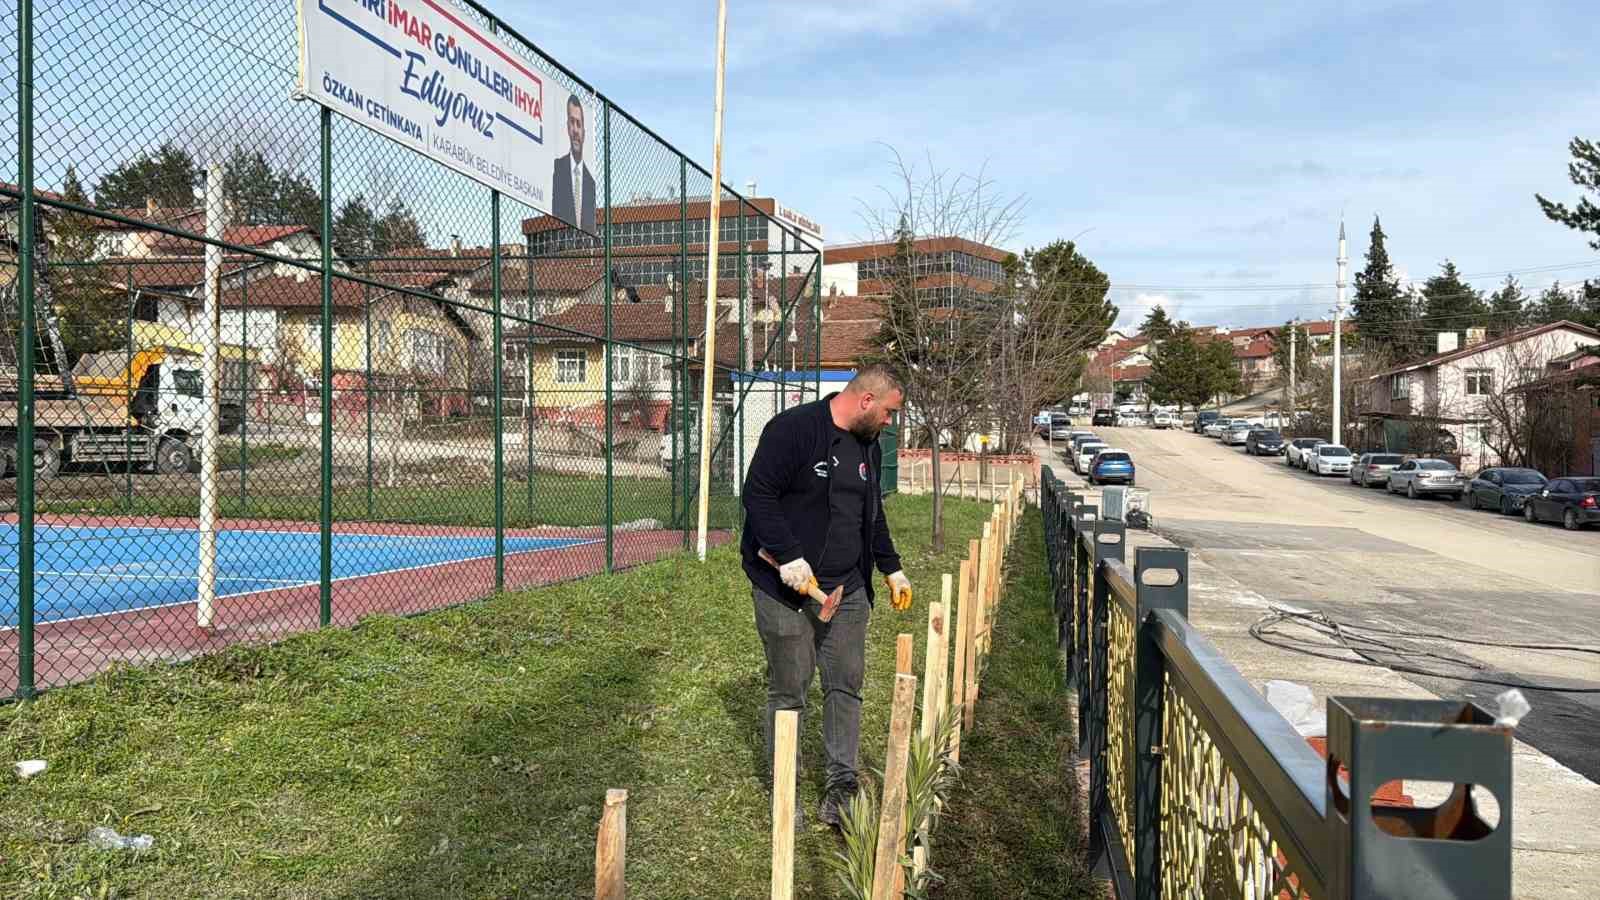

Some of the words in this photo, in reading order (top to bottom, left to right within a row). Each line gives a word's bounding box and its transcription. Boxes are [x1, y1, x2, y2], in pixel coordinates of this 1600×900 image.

[322, 71, 363, 111] ÖZKAN
[366, 98, 423, 141] ÇETİNKAYA
[400, 49, 494, 138] Ediyoruz
